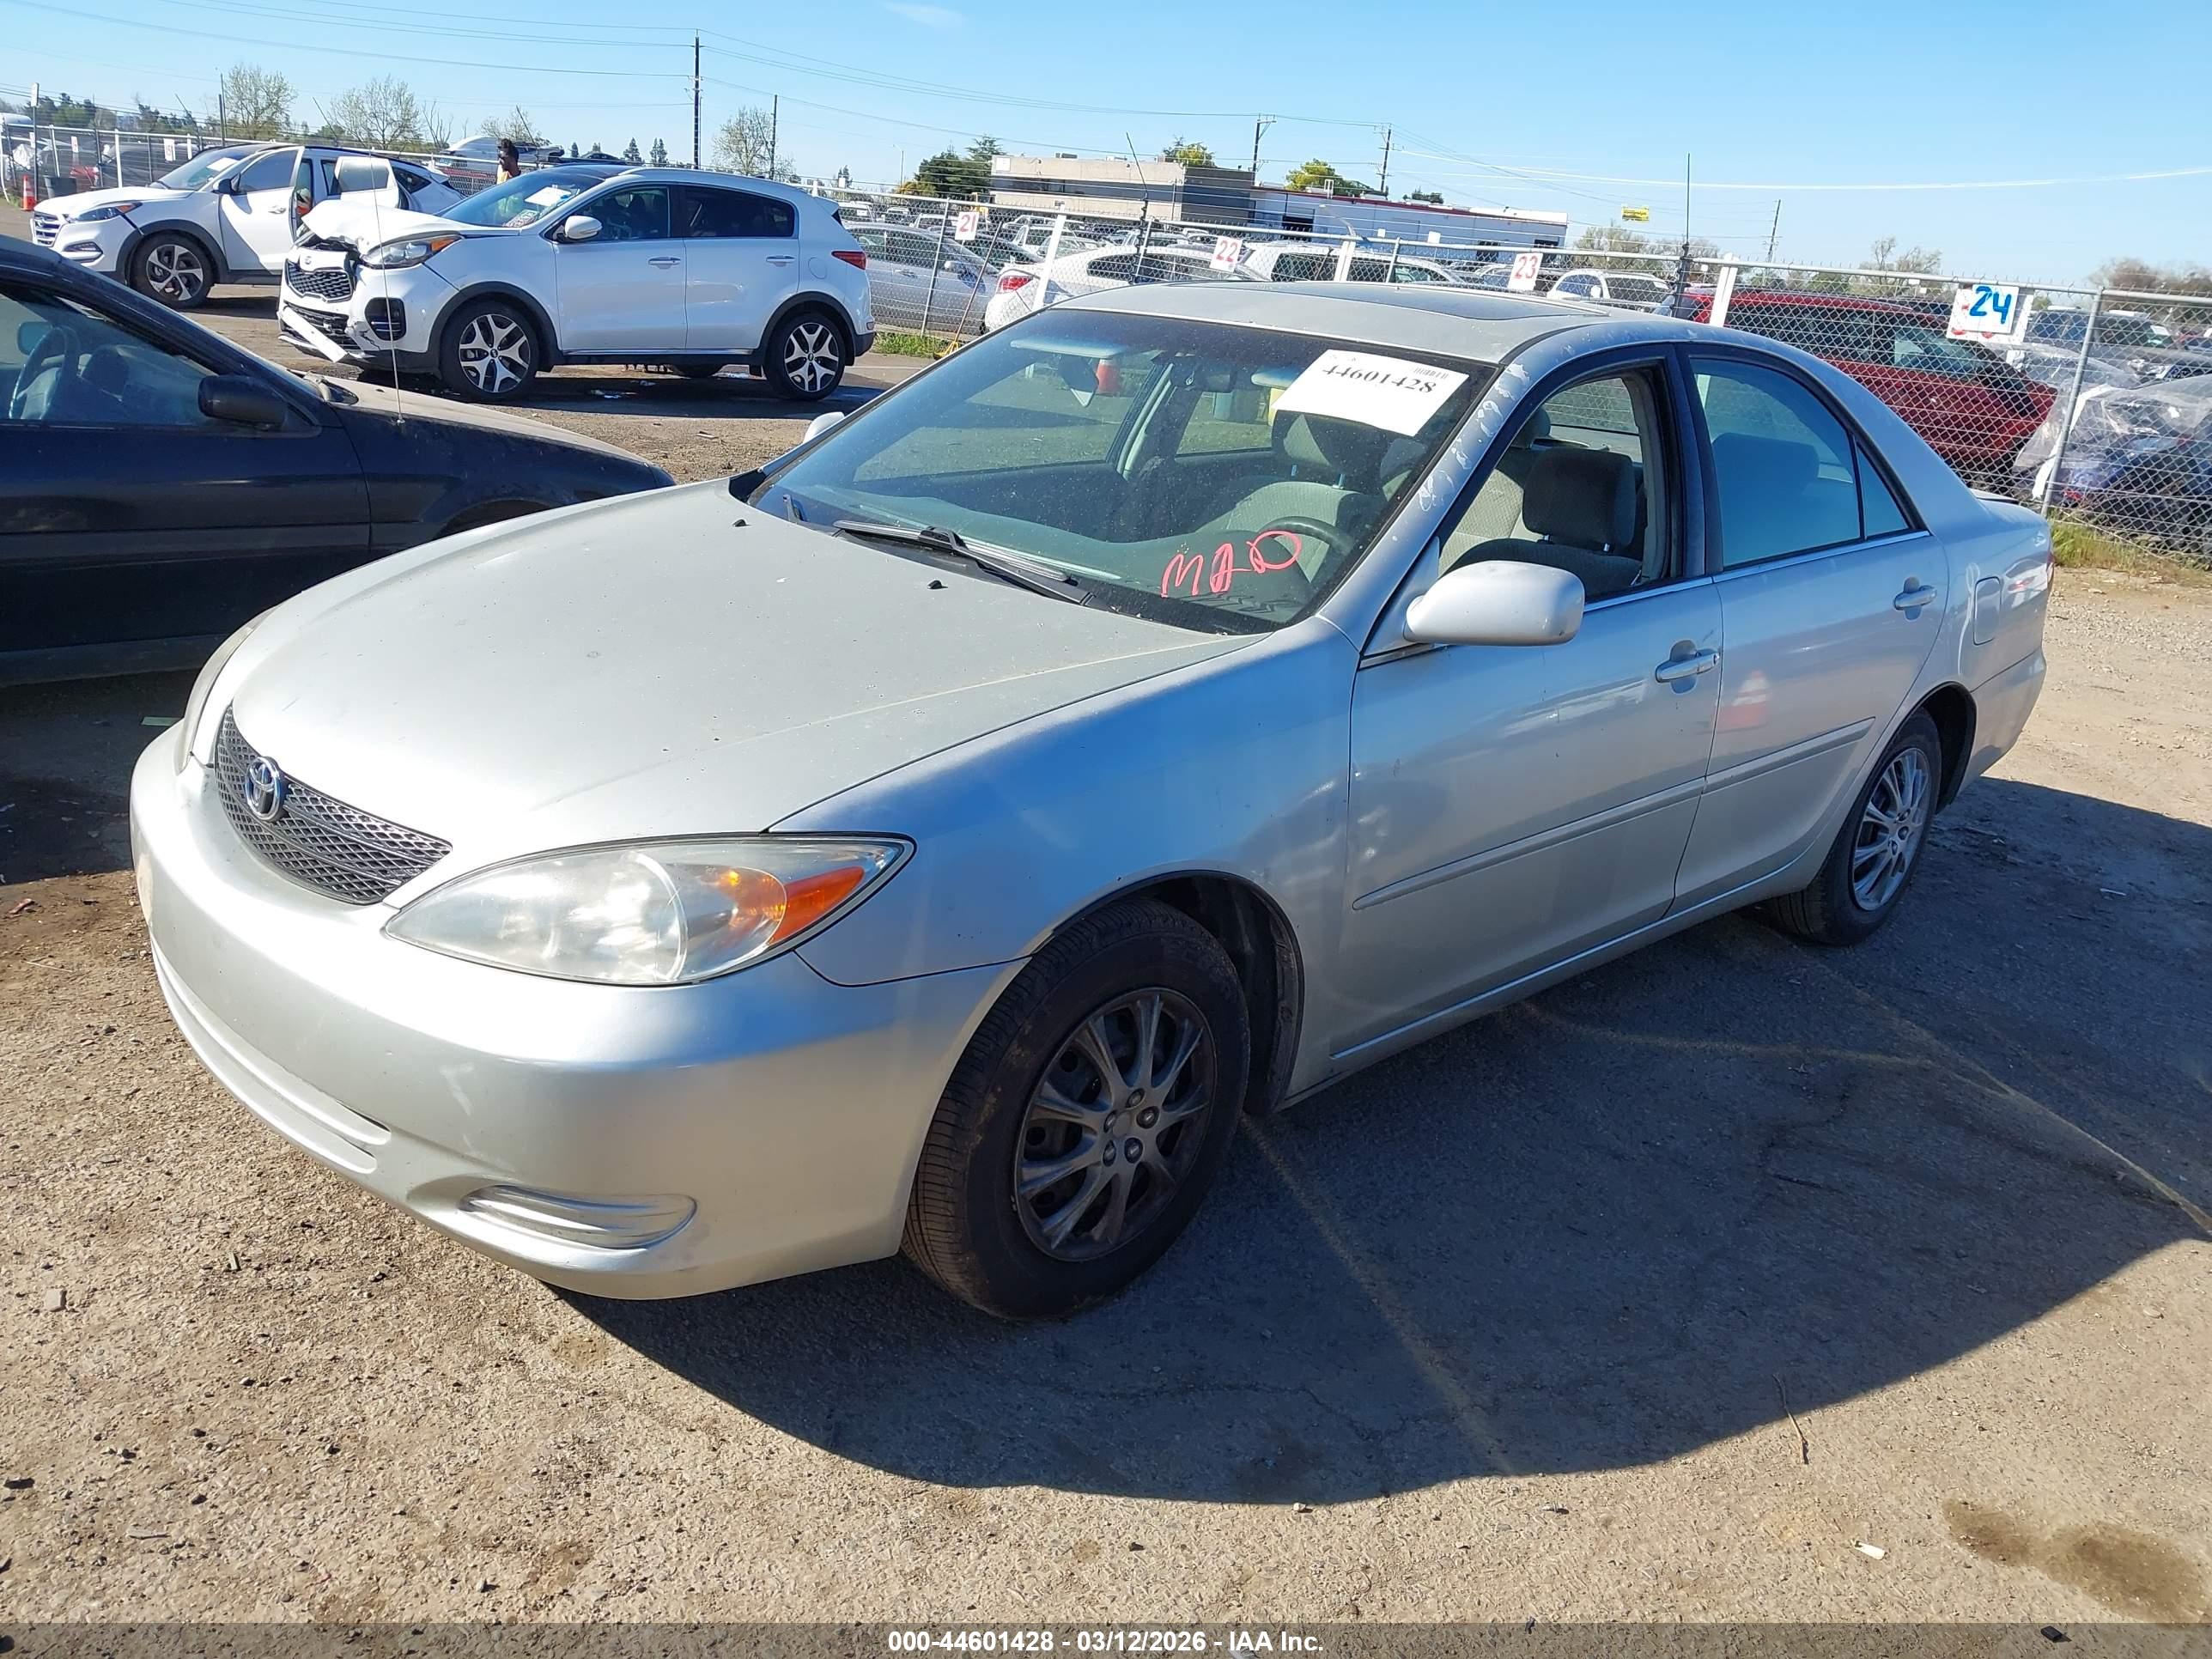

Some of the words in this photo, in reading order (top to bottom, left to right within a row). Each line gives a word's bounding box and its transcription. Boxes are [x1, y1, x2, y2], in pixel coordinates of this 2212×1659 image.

[959, 214, 976, 233] 21
[1216, 240, 1238, 262] 22
[1515, 255, 1538, 279] 23
[1969, 285, 2012, 325] 24
[1322, 364, 1437, 393] 44601428
